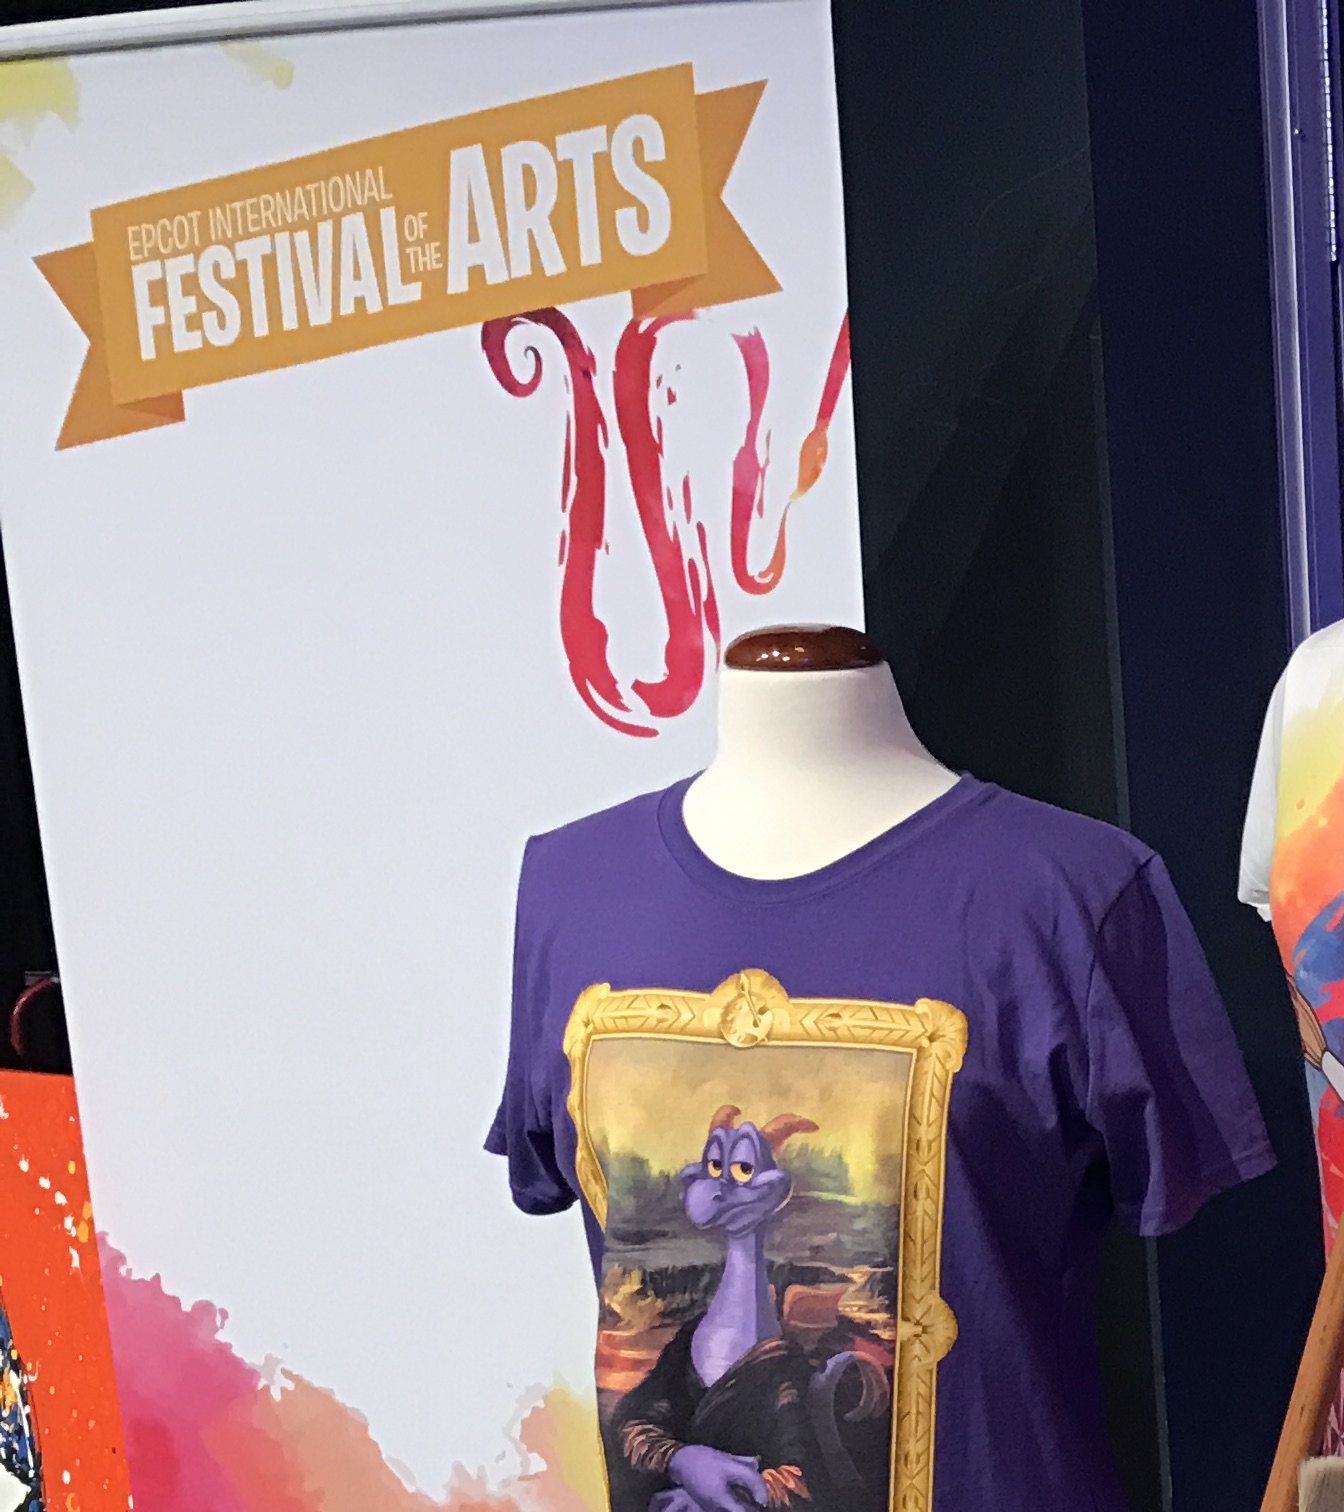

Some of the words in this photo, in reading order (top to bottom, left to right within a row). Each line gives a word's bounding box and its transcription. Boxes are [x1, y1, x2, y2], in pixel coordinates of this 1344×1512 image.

[128, 211, 202, 262] EPCOT
[209, 165, 393, 241] INTERNATIONAL
[404, 212, 428, 244] OF
[446, 113, 673, 296] ARTS
[131, 206, 422, 361] FESTIVAL
[406, 242, 443, 275] THE
